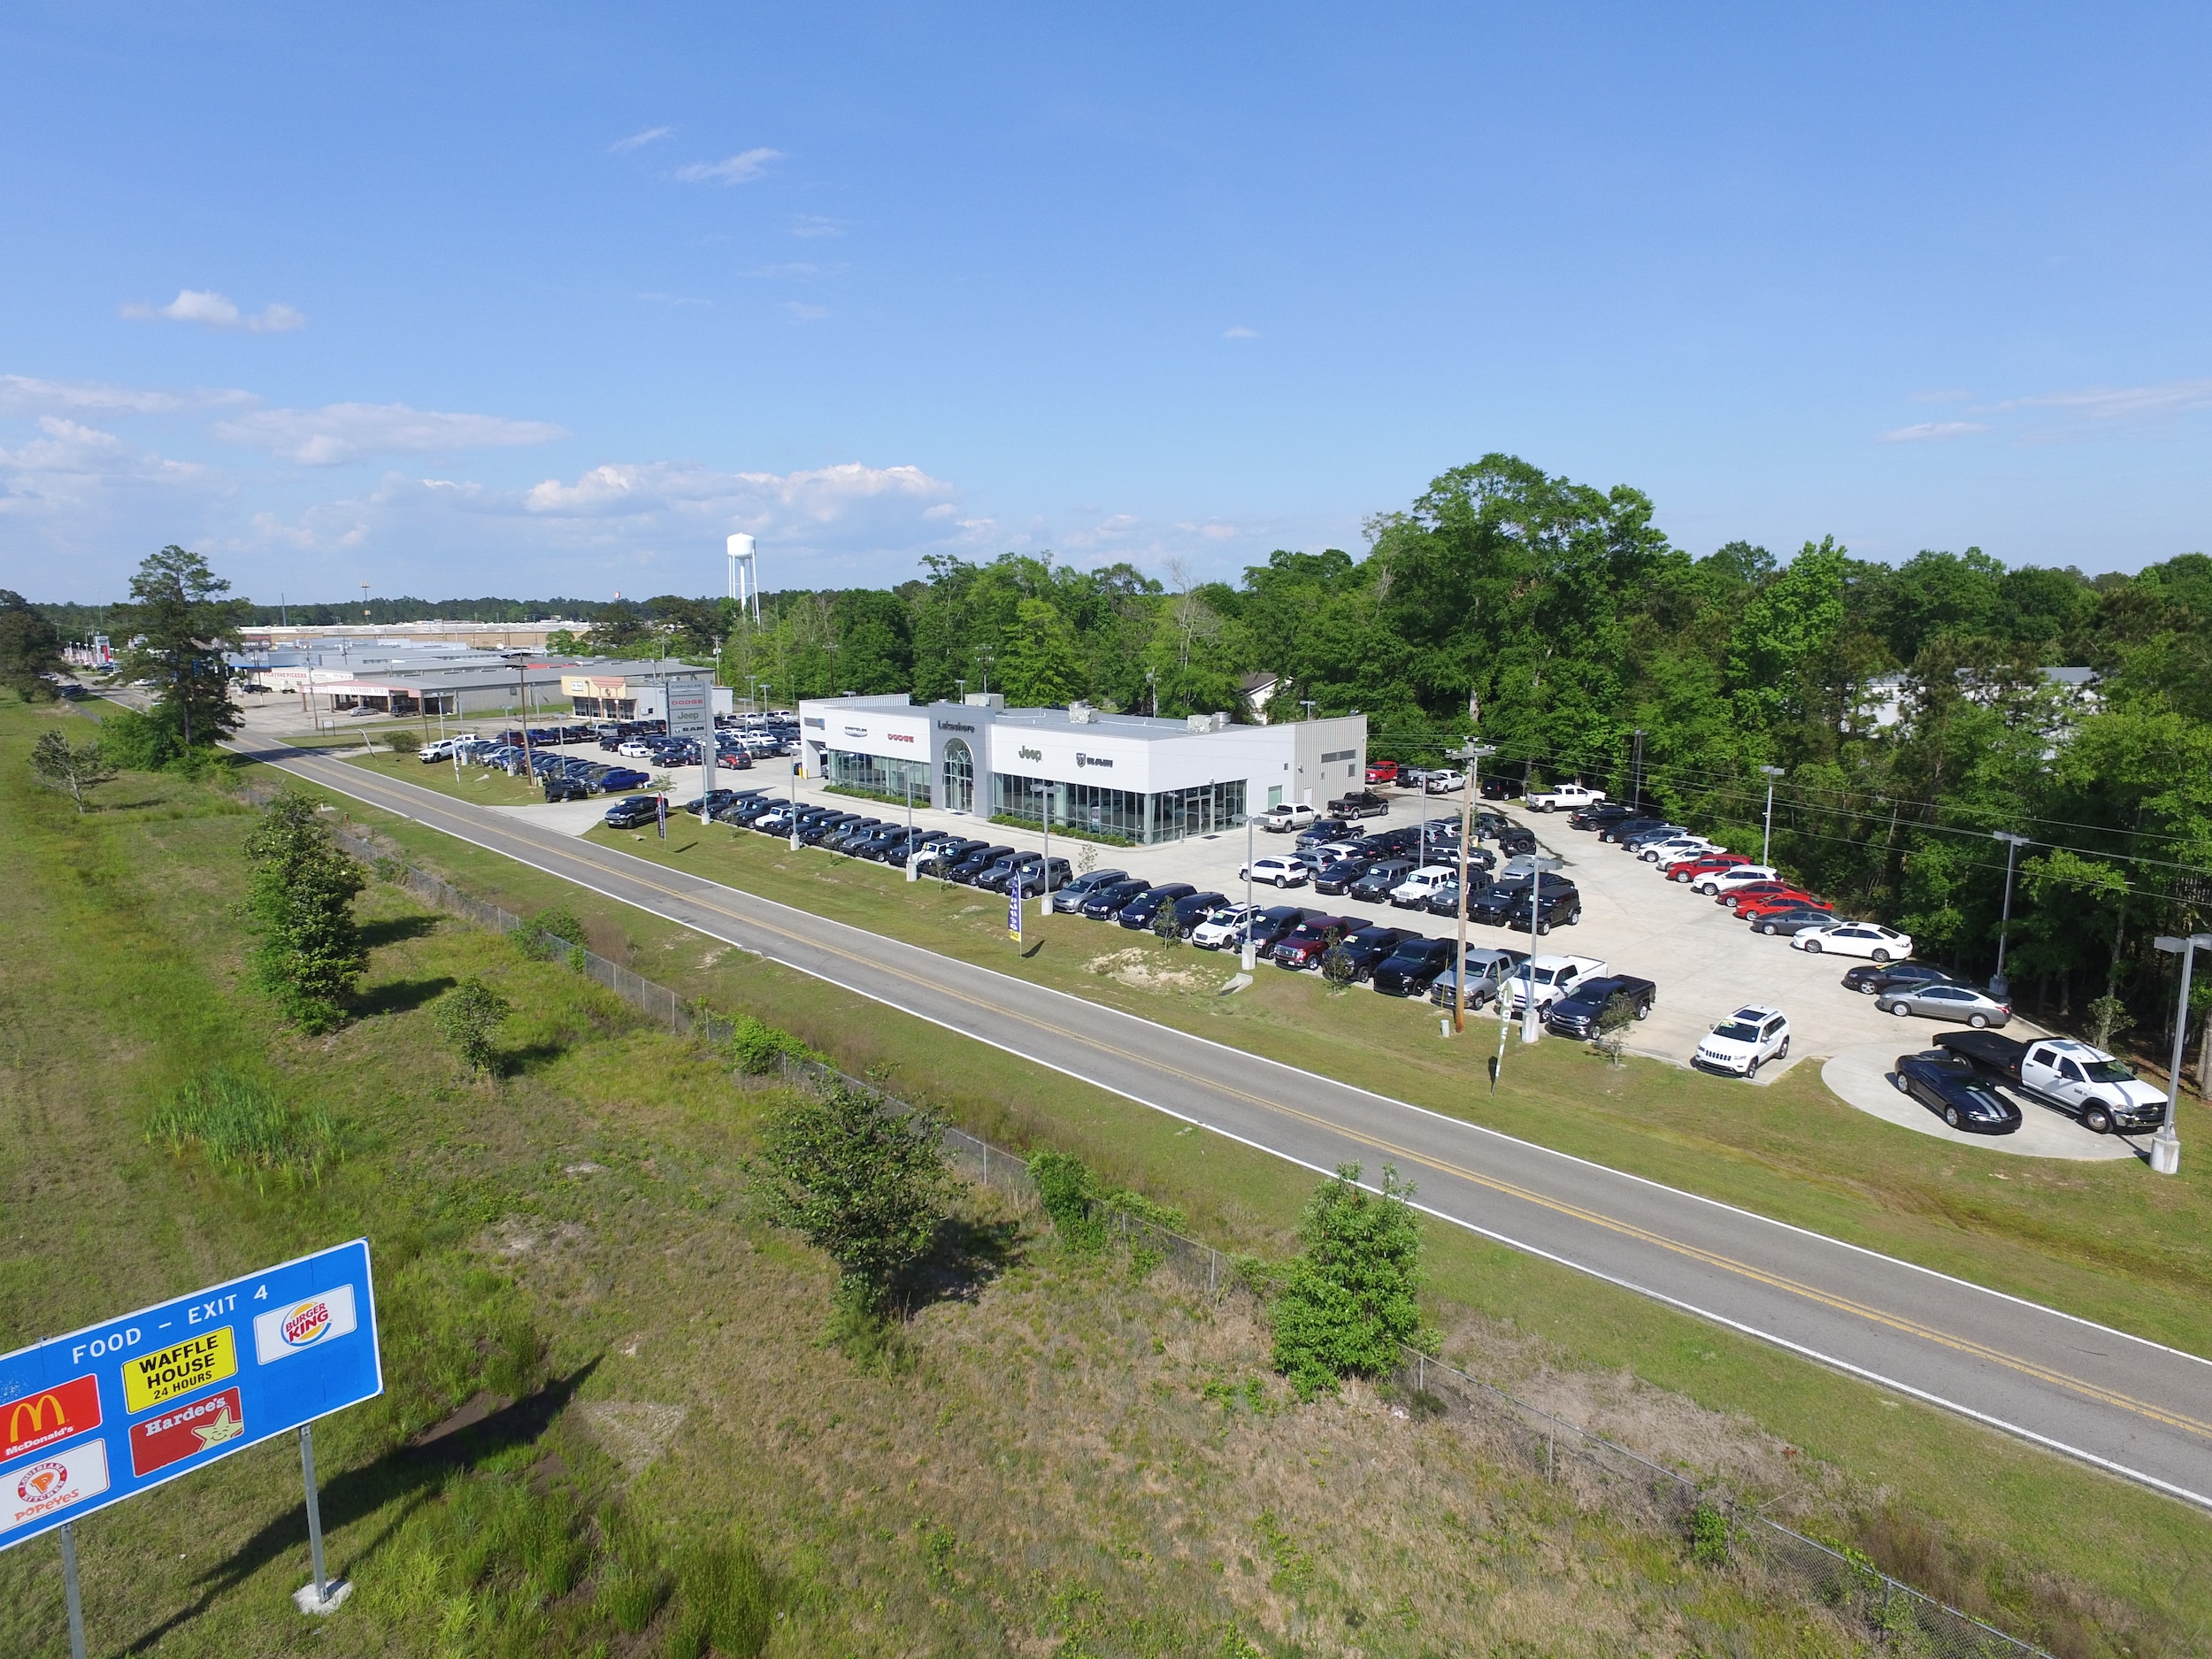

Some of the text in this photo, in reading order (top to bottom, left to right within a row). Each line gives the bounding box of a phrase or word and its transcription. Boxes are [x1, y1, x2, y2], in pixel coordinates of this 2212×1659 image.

[678, 711, 699, 720] Jeep
[887, 733, 915, 743] DODGE
[1018, 745, 1042, 763] Jeep
[1087, 757, 1113, 768] RAM
[72, 1327, 142, 1364] FOOD
[188, 1294, 238, 1325] EXIT
[254, 1284, 268, 1300] 4
[285, 1302, 326, 1333] BURGER
[288, 1310, 329, 1342] KING
[139, 1335, 219, 1374] WAFFLE
[147, 1353, 216, 1389] HOUSE
[153, 1371, 213, 1401] 24 HOURS
[144, 1396, 227, 1437] Hardee's
[5, 1425, 75, 1456] McDonald's
[19, 1462, 65, 1489] LOUISIANA
[24, 1479, 65, 1502] KITCHEN
